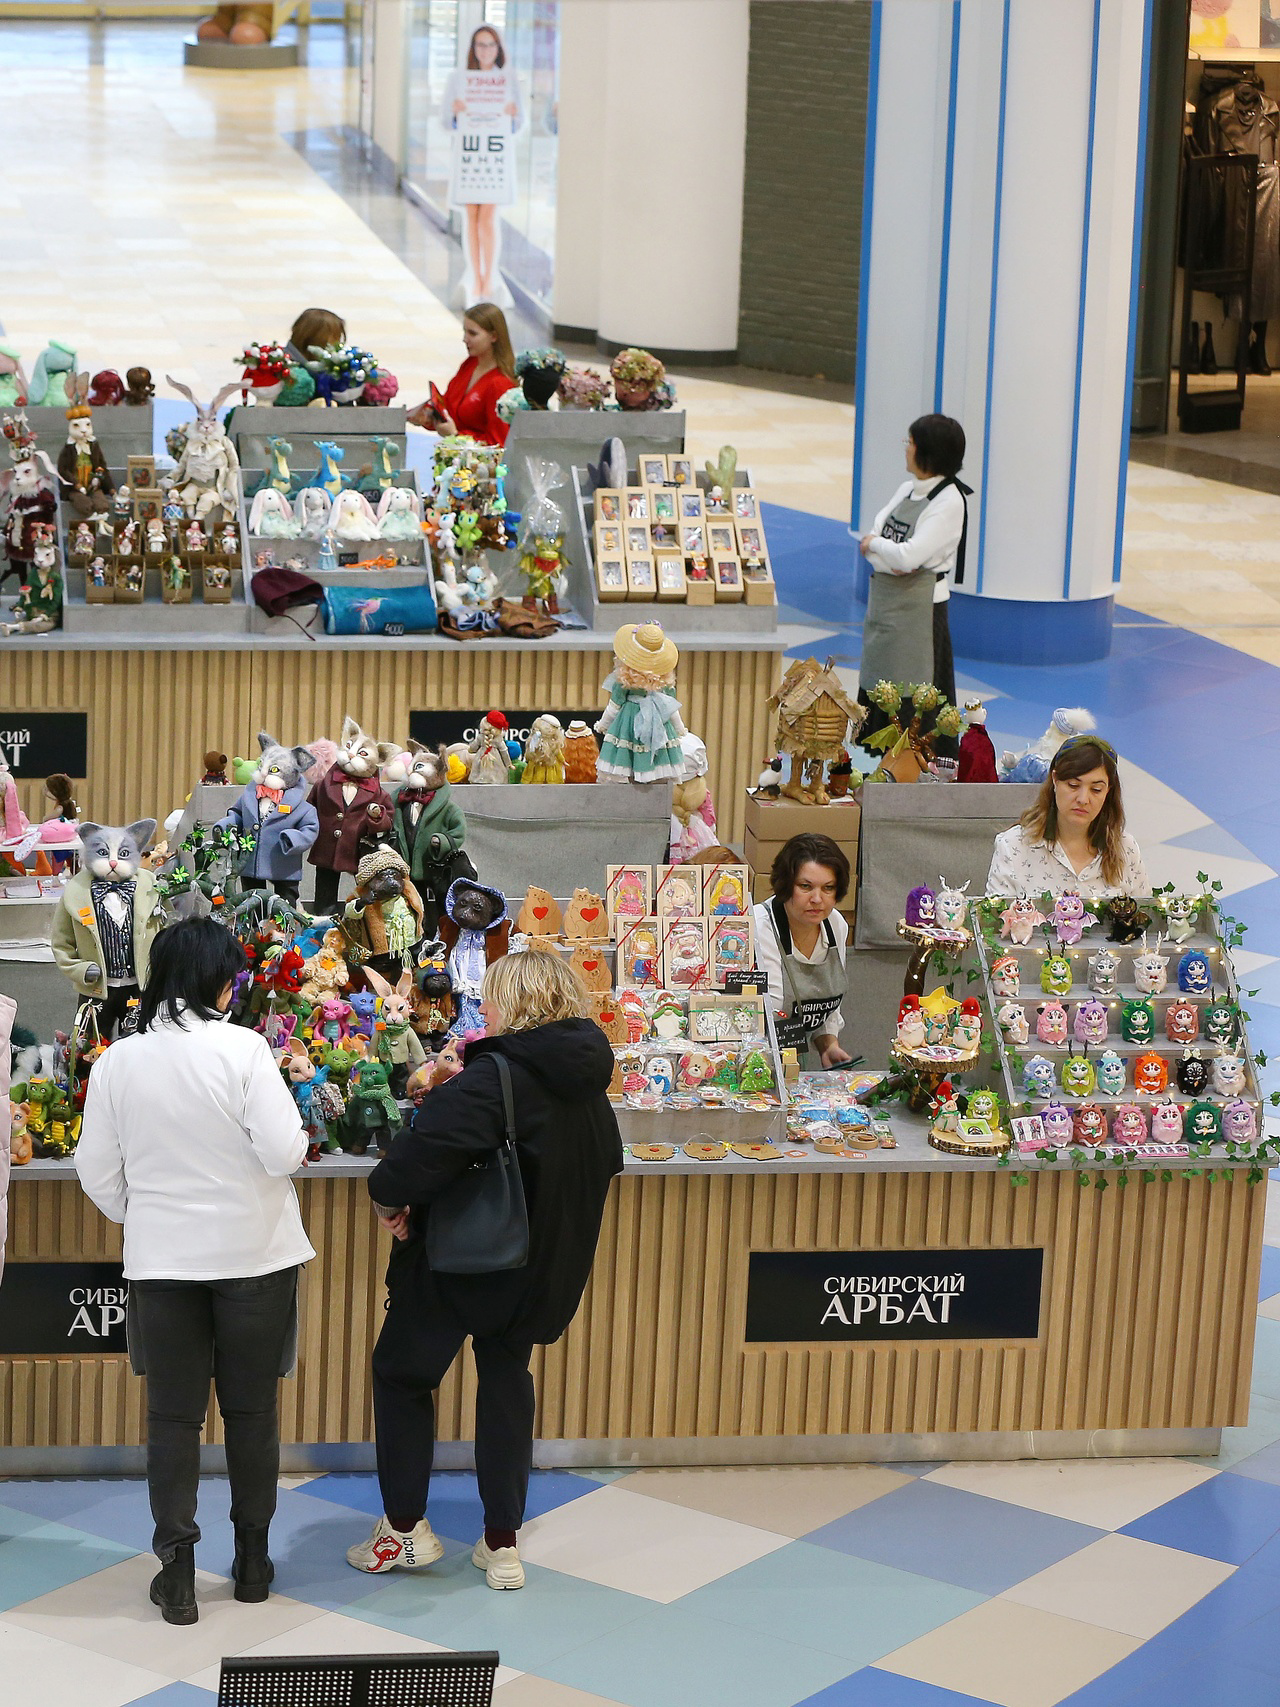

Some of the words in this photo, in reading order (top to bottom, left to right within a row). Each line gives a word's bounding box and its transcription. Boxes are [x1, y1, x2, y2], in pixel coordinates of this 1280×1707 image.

[463, 135, 480, 152] Ш
[488, 135, 504, 152] Б
[823, 1272, 966, 1294] СИБИРСКИЙ
[820, 1293, 961, 1325] АРБАТ
[402, 1536, 416, 1565] GUCCI
